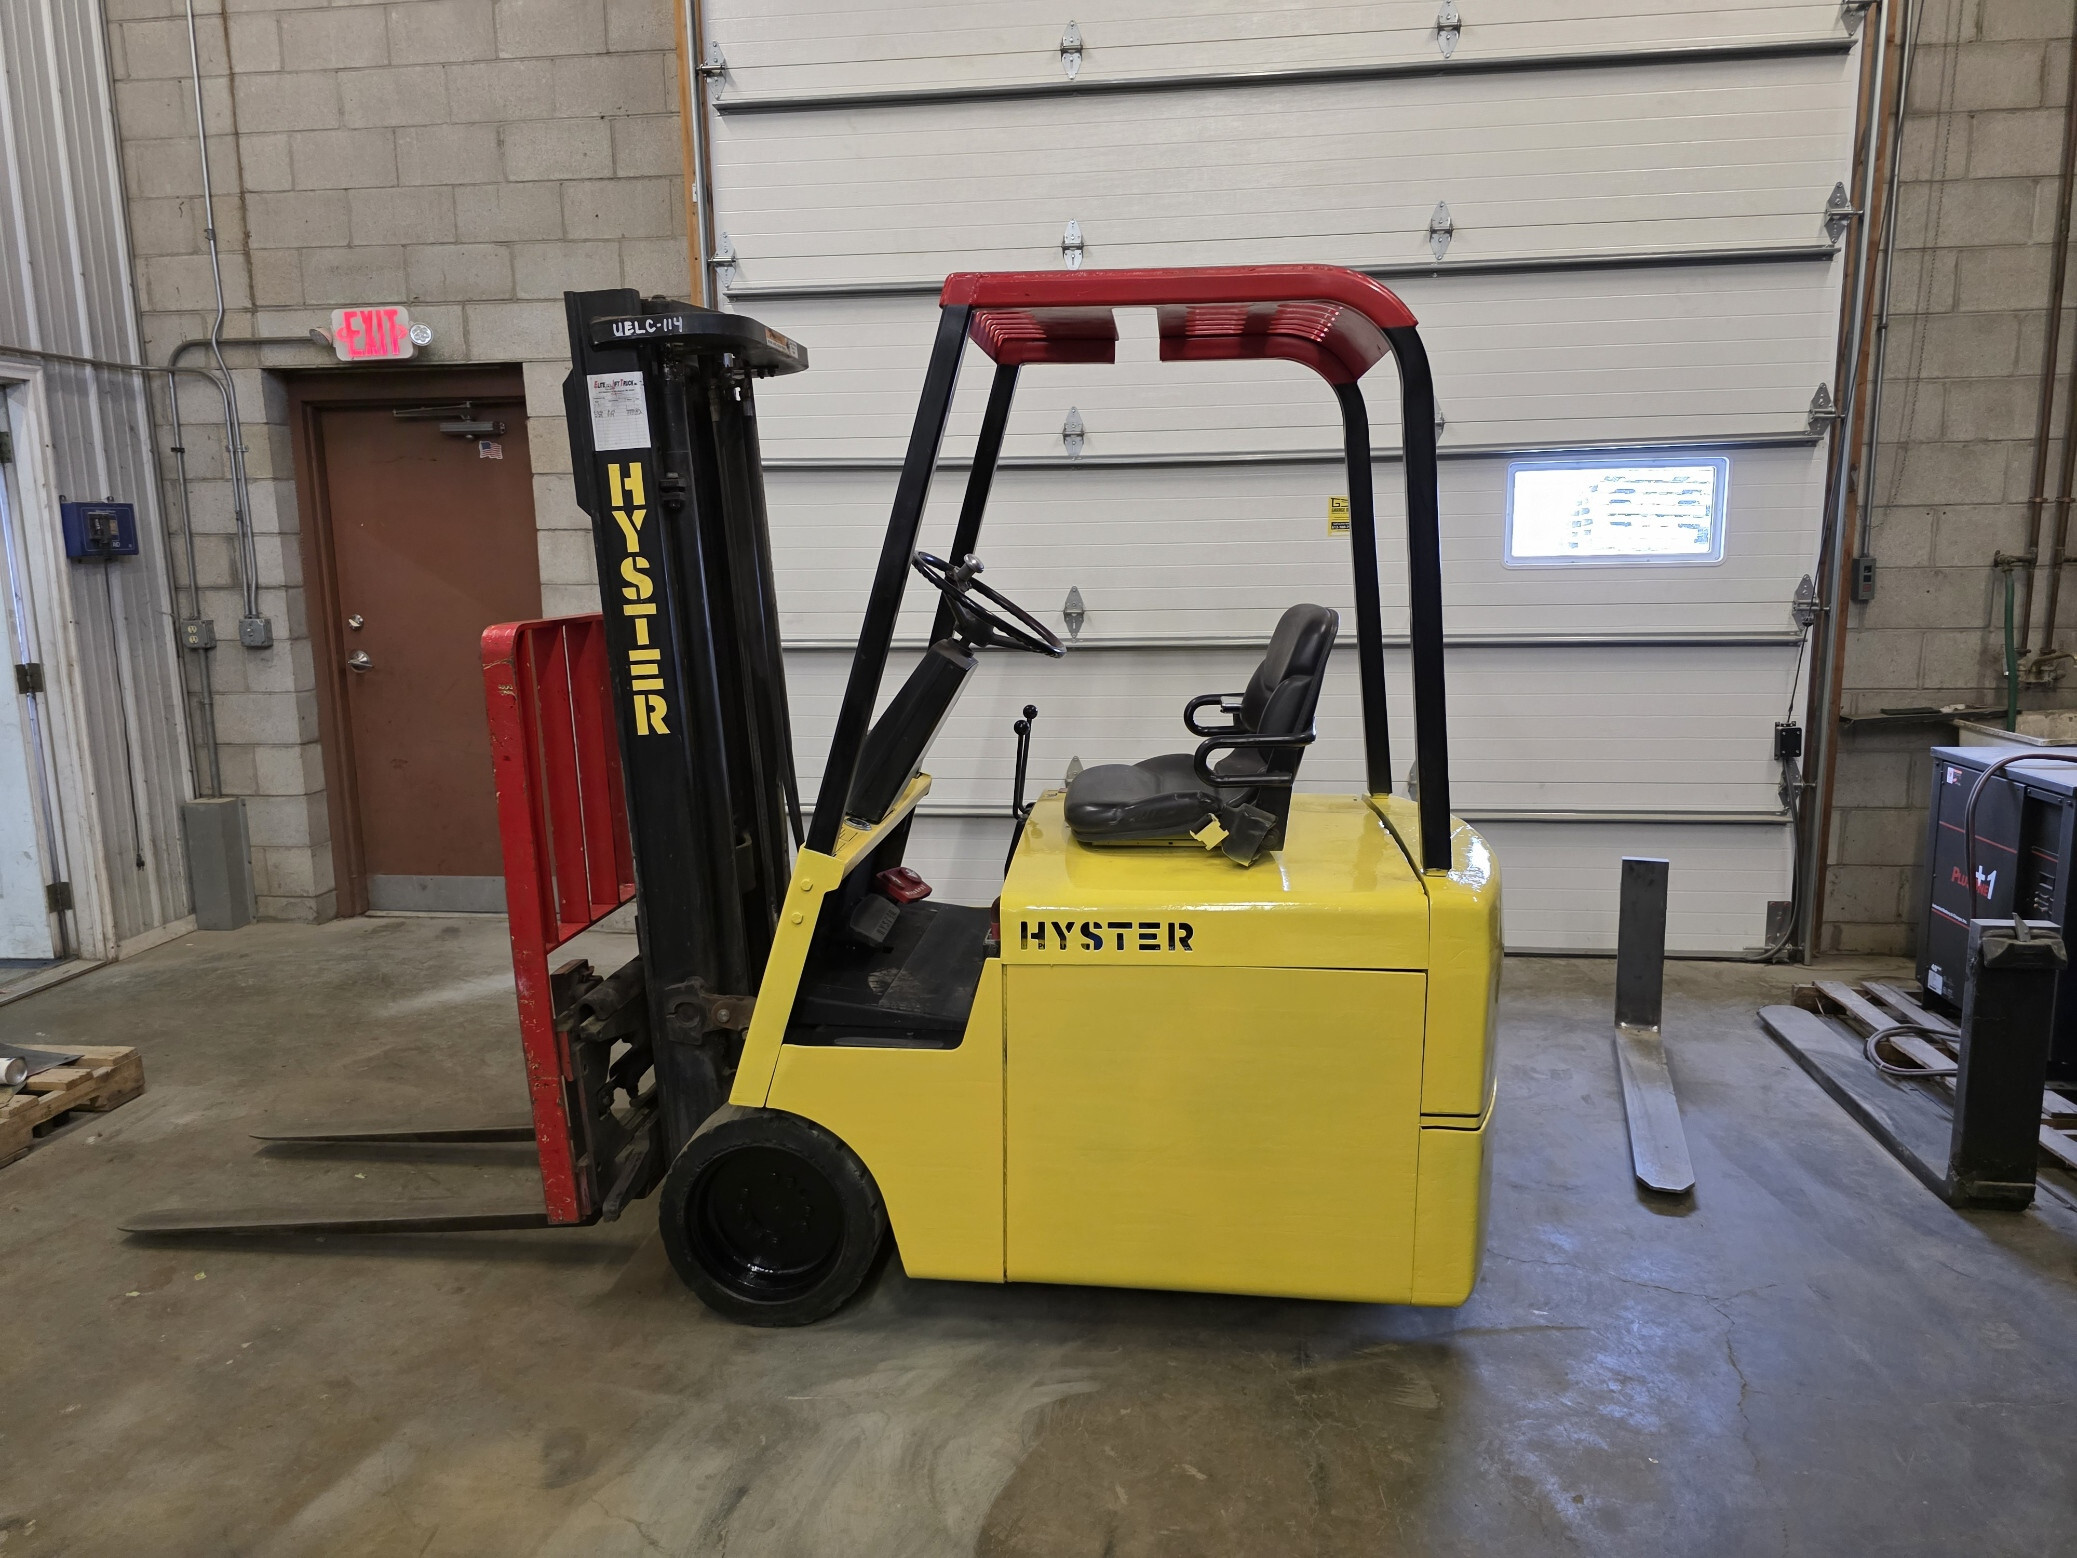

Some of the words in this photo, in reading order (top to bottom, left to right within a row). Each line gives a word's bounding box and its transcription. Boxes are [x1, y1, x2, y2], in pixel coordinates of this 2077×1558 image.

[343, 309, 399, 357] EXIT
[607, 462, 671, 736] HYSTER
[1020, 921, 1194, 951] HYSTER
